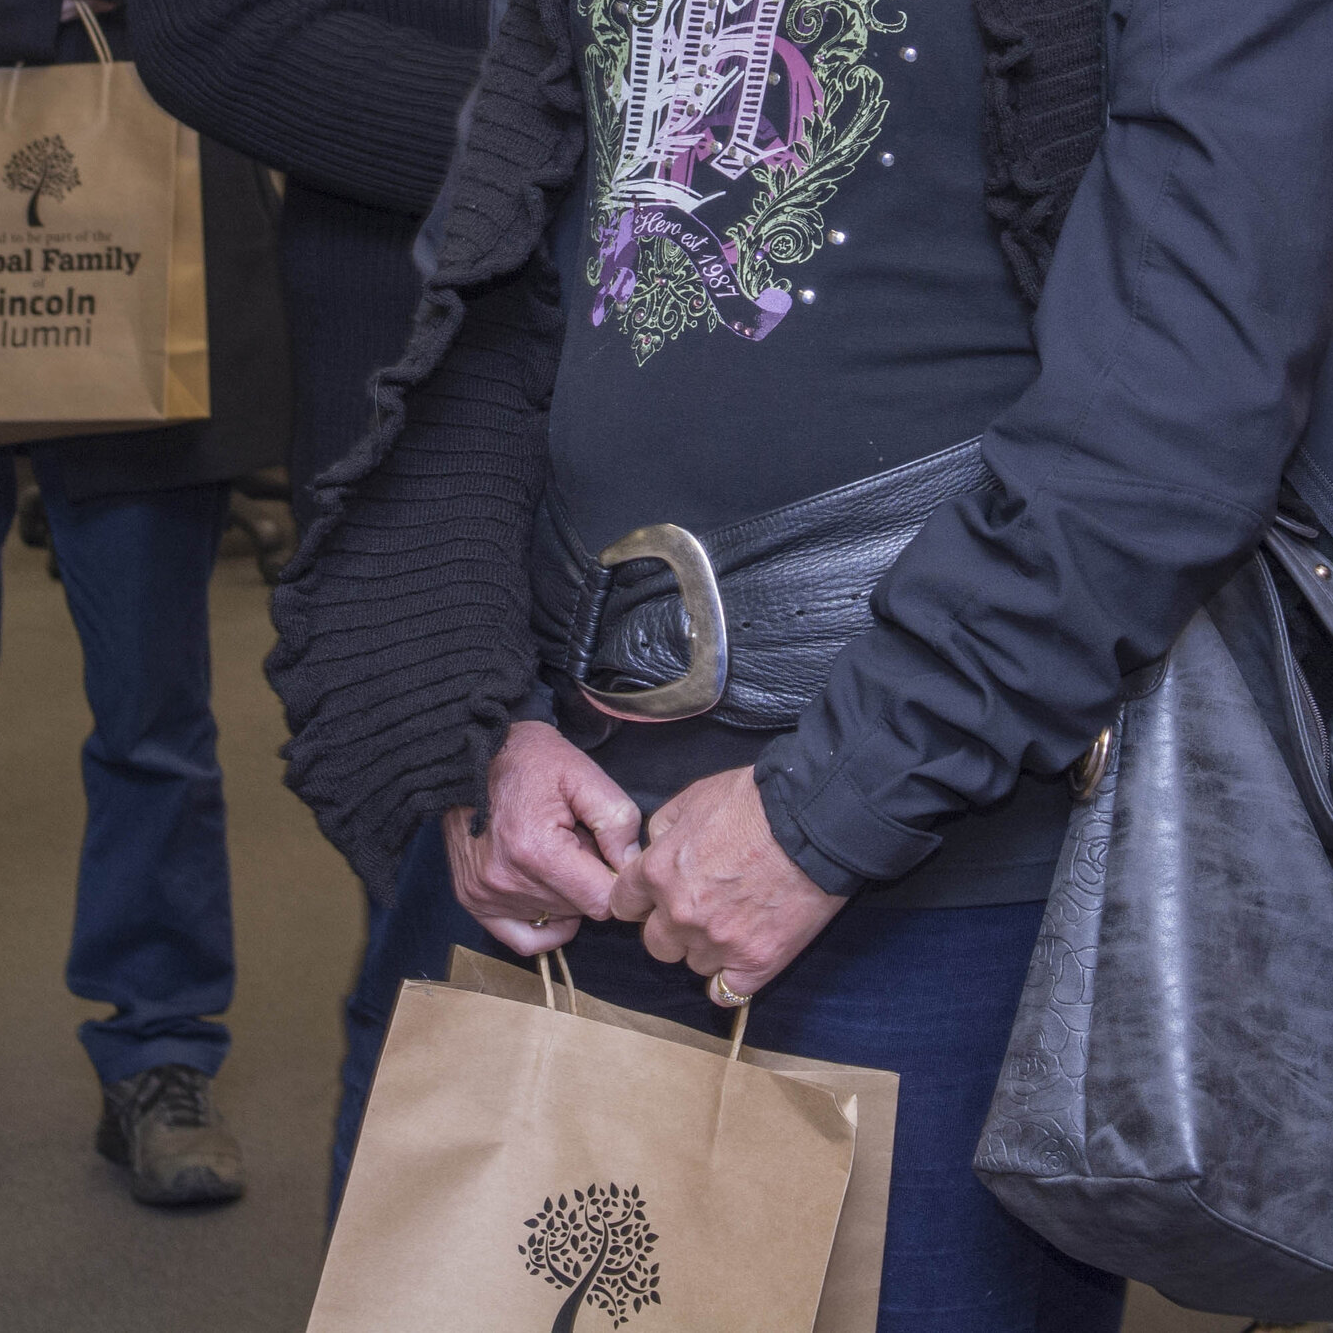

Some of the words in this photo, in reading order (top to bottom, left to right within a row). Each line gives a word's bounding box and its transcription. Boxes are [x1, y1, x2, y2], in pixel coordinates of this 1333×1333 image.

[42, 245, 142, 276] Family
[633, 212, 682, 235] Hero
[681, 233, 709, 252] est
[698, 254, 740, 298] 1987
